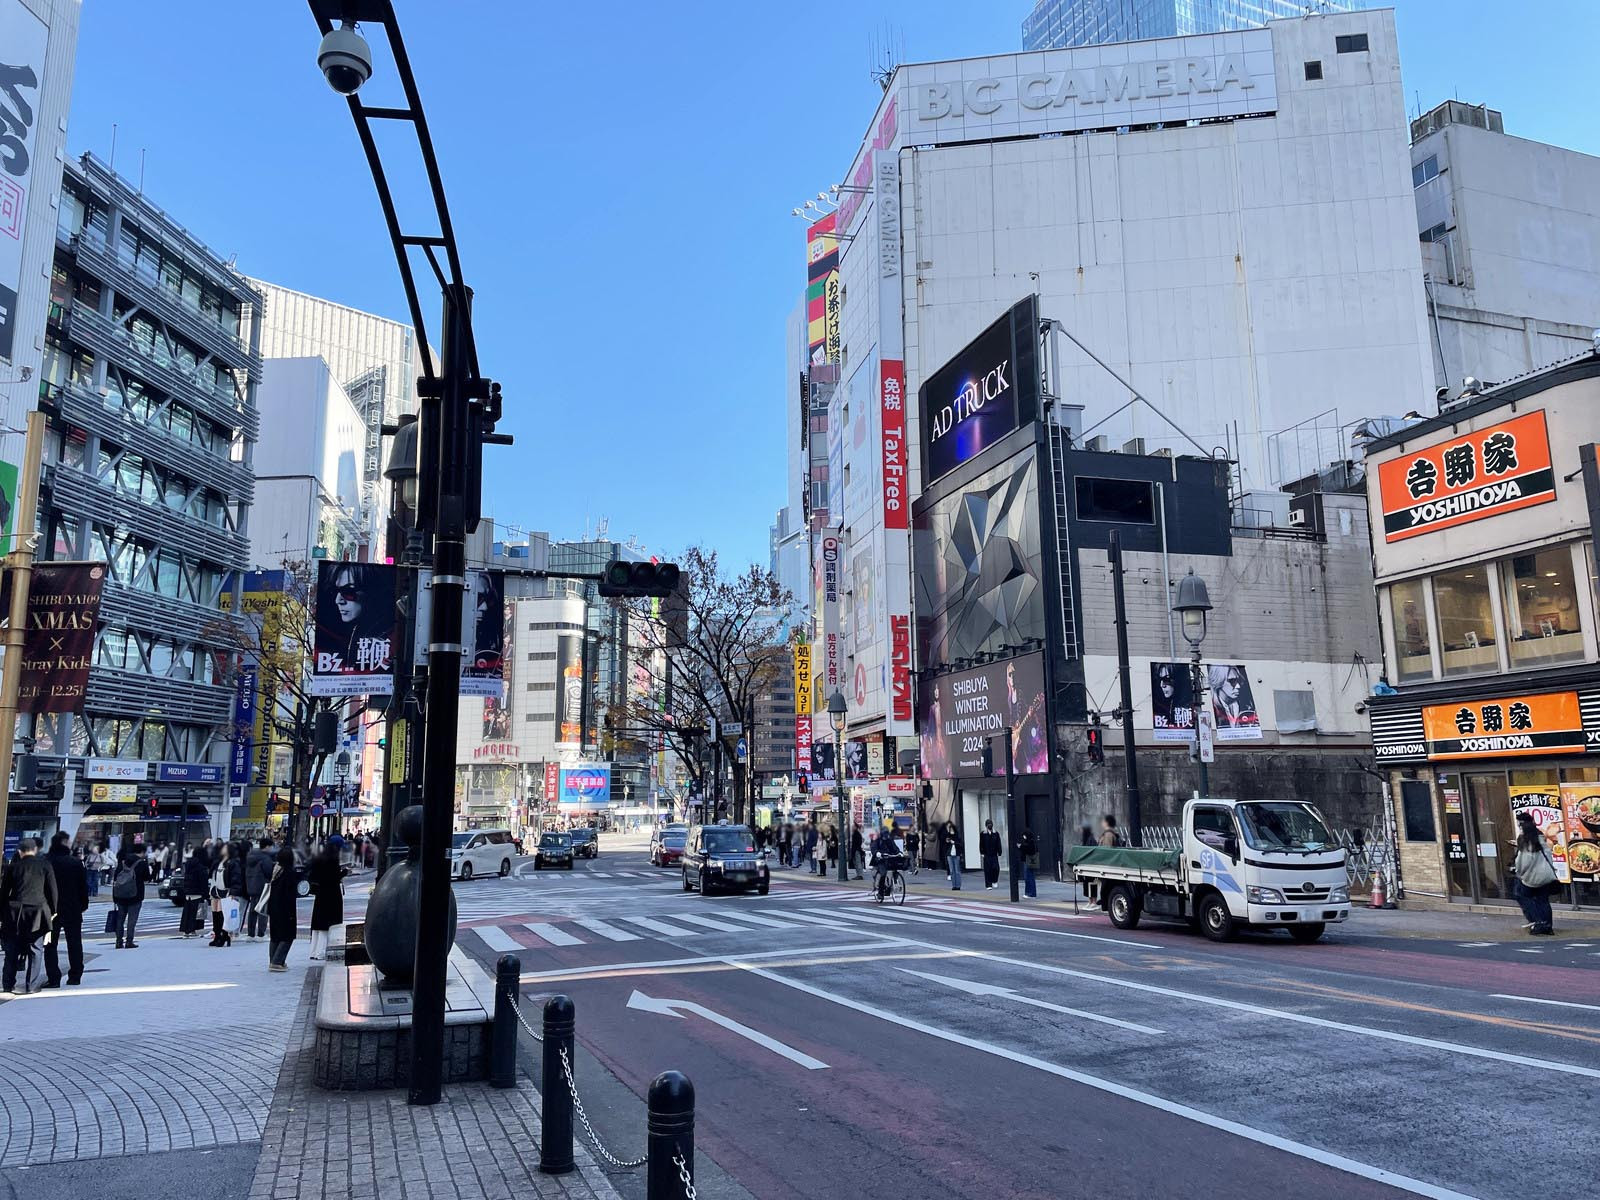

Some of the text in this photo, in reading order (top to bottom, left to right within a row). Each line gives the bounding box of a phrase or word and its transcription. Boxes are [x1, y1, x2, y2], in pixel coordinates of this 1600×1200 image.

[918, 54, 1255, 121] BIC CAMERA
[880, 162, 898, 279] BIC CAMERA
[884, 377, 900, 410] 免税
[931, 359, 1010, 443] AD TRUCK
[885, 427, 903, 511] TaxFree
[1405, 430, 1520, 500] 吉野家
[1409, 480, 1522, 526] YOSHINOYA
[29, 594, 100, 606] SHIBUYA109
[31, 610, 94, 631] XMAS
[57, 655, 90, 670] Kids
[356, 637, 391, 672] 鞭
[827, 633, 838, 686] 処方せん受付
[797, 646, 810, 694] 処方せん
[953, 676, 989, 697] SHIBUYA
[800, 694, 808, 712] 3F
[955, 695, 989, 715] WINTER
[945, 713, 1003, 736] ILLUMINATION
[1455, 702, 1532, 734] 吉野家
[473, 743, 520, 758] MAGNET
[963, 736, 984, 752] 2024
[1376, 743, 1426, 755] YOSHINOYA
[1460, 735, 1534, 752] YOSHINOYA
[168, 766, 188, 776] MIZUHO
[1512, 792, 1560, 808] から揚げ祭
